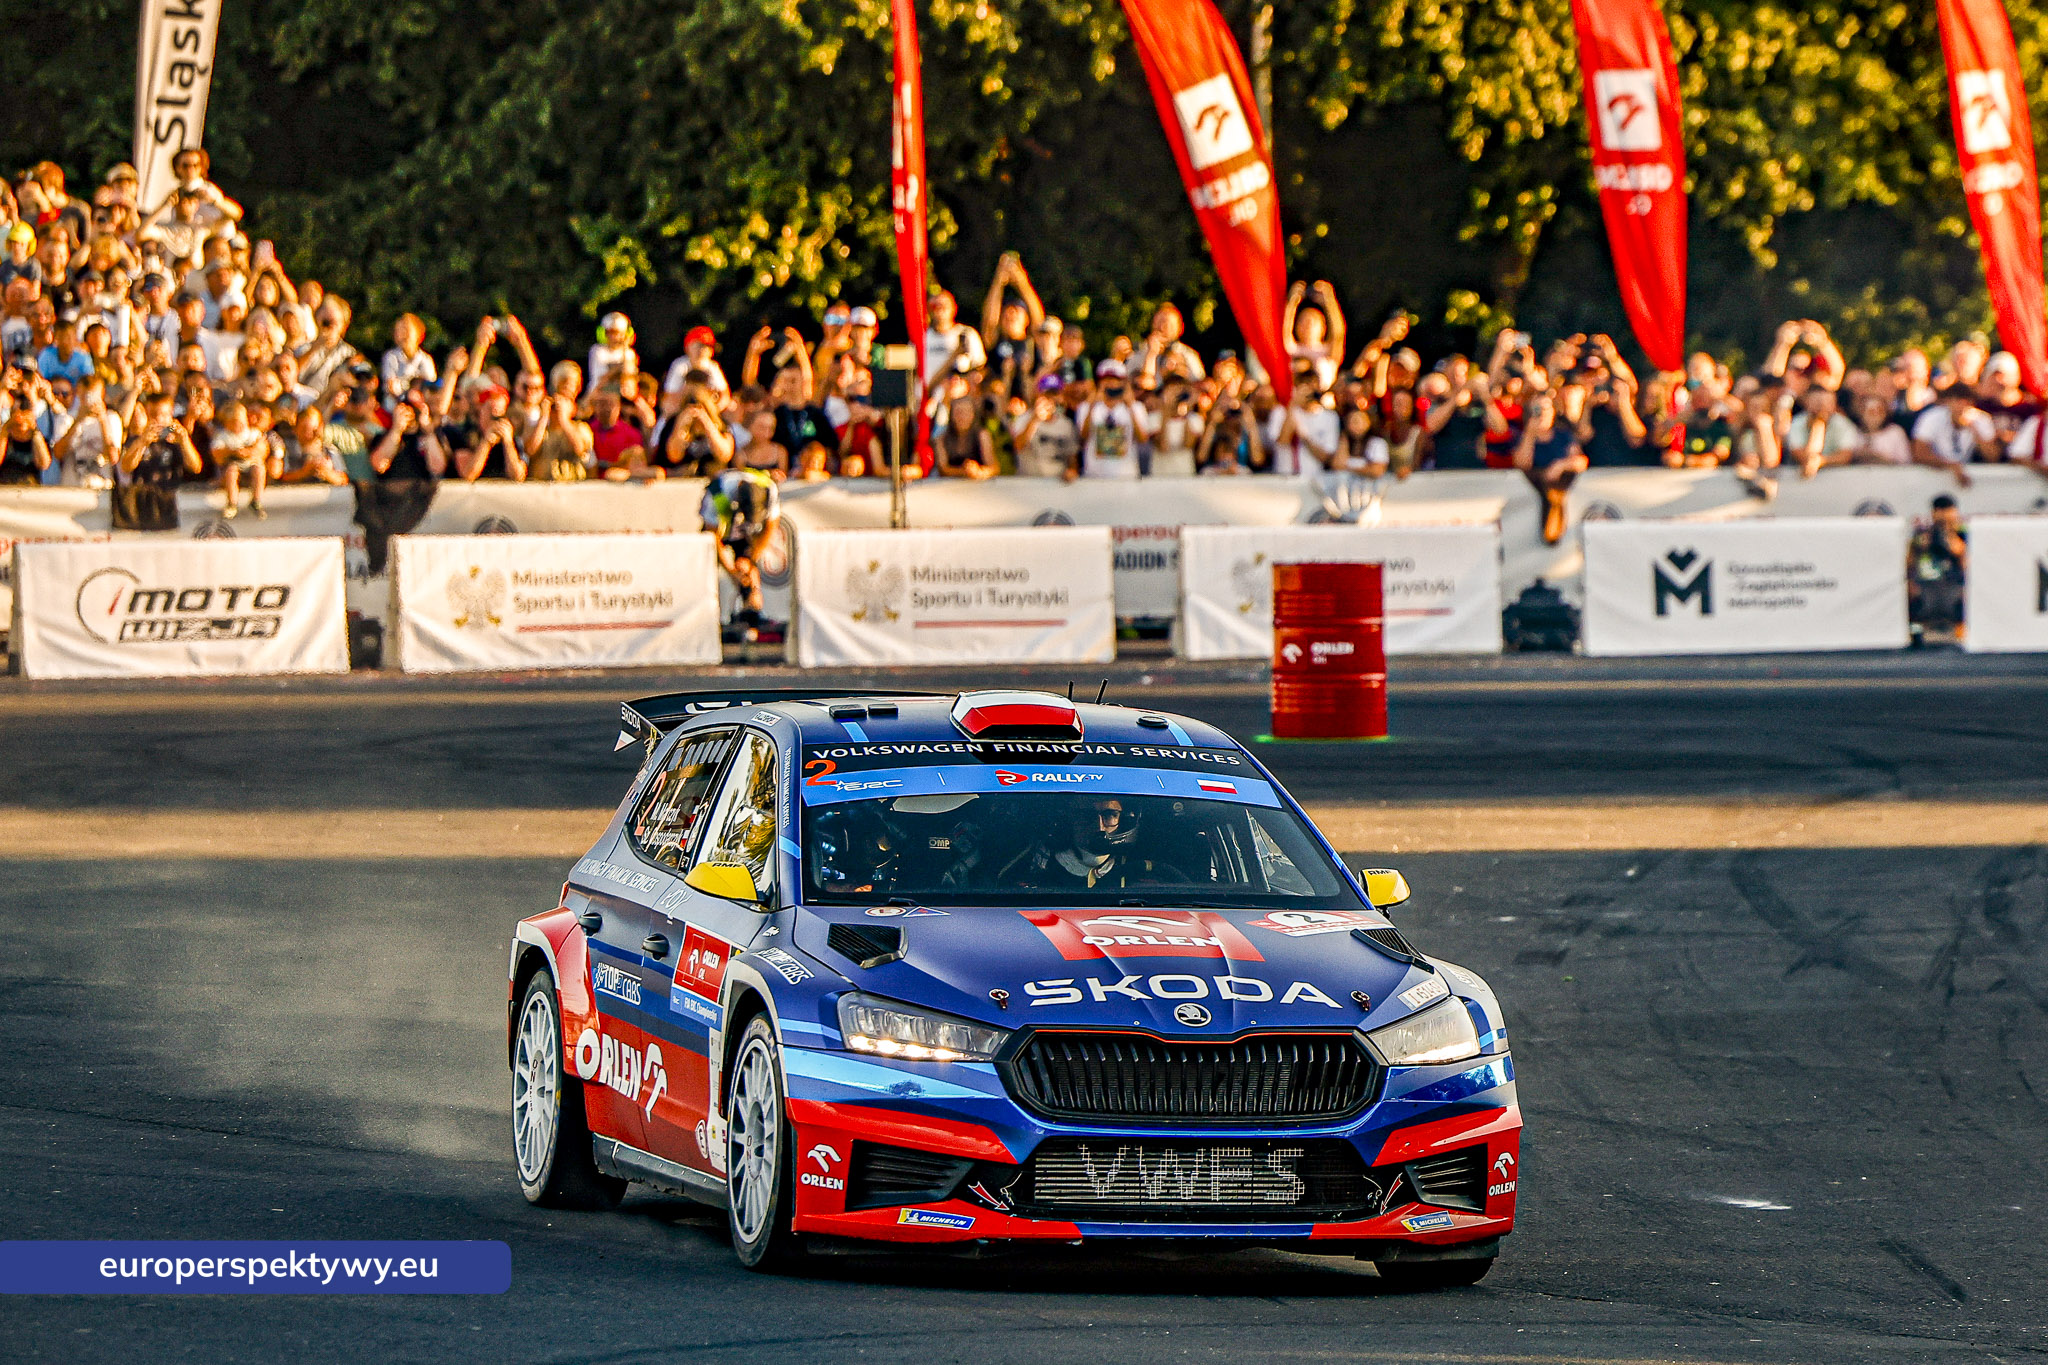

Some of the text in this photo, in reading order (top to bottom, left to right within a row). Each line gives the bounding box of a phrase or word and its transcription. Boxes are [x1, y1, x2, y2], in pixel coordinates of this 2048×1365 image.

[512, 567, 633, 587] Ministerstwo
[909, 565, 1030, 584] Ministerstwo
[127, 584, 291, 614] MOTO
[513, 590, 576, 613] Sportu
[590, 588, 673, 612] Turystyki
[911, 587, 973, 611] Sportu
[986, 586, 1069, 609] Turystyki
[1310, 641, 1355, 655] ORLEN
[812, 743, 1241, 766] VOLKSWAGEN FINANCIAL SERVICES
[804, 759, 838, 787] 2
[843, 779, 904, 792] ERC
[929, 838, 951, 847] OMP
[1282, 913, 1326, 923] 2
[1082, 935, 1224, 948] ORLEN
[702, 949, 721, 970] ORLEN
[622, 976, 642, 1005] CARS
[575, 1028, 642, 1102] ORLEN
[800, 1173, 844, 1191] ORLEN
[1488, 1180, 1517, 1197] ORLEN
[919, 1215, 968, 1226] MICHELIN
[1419, 1216, 1448, 1227] MICHELIN
